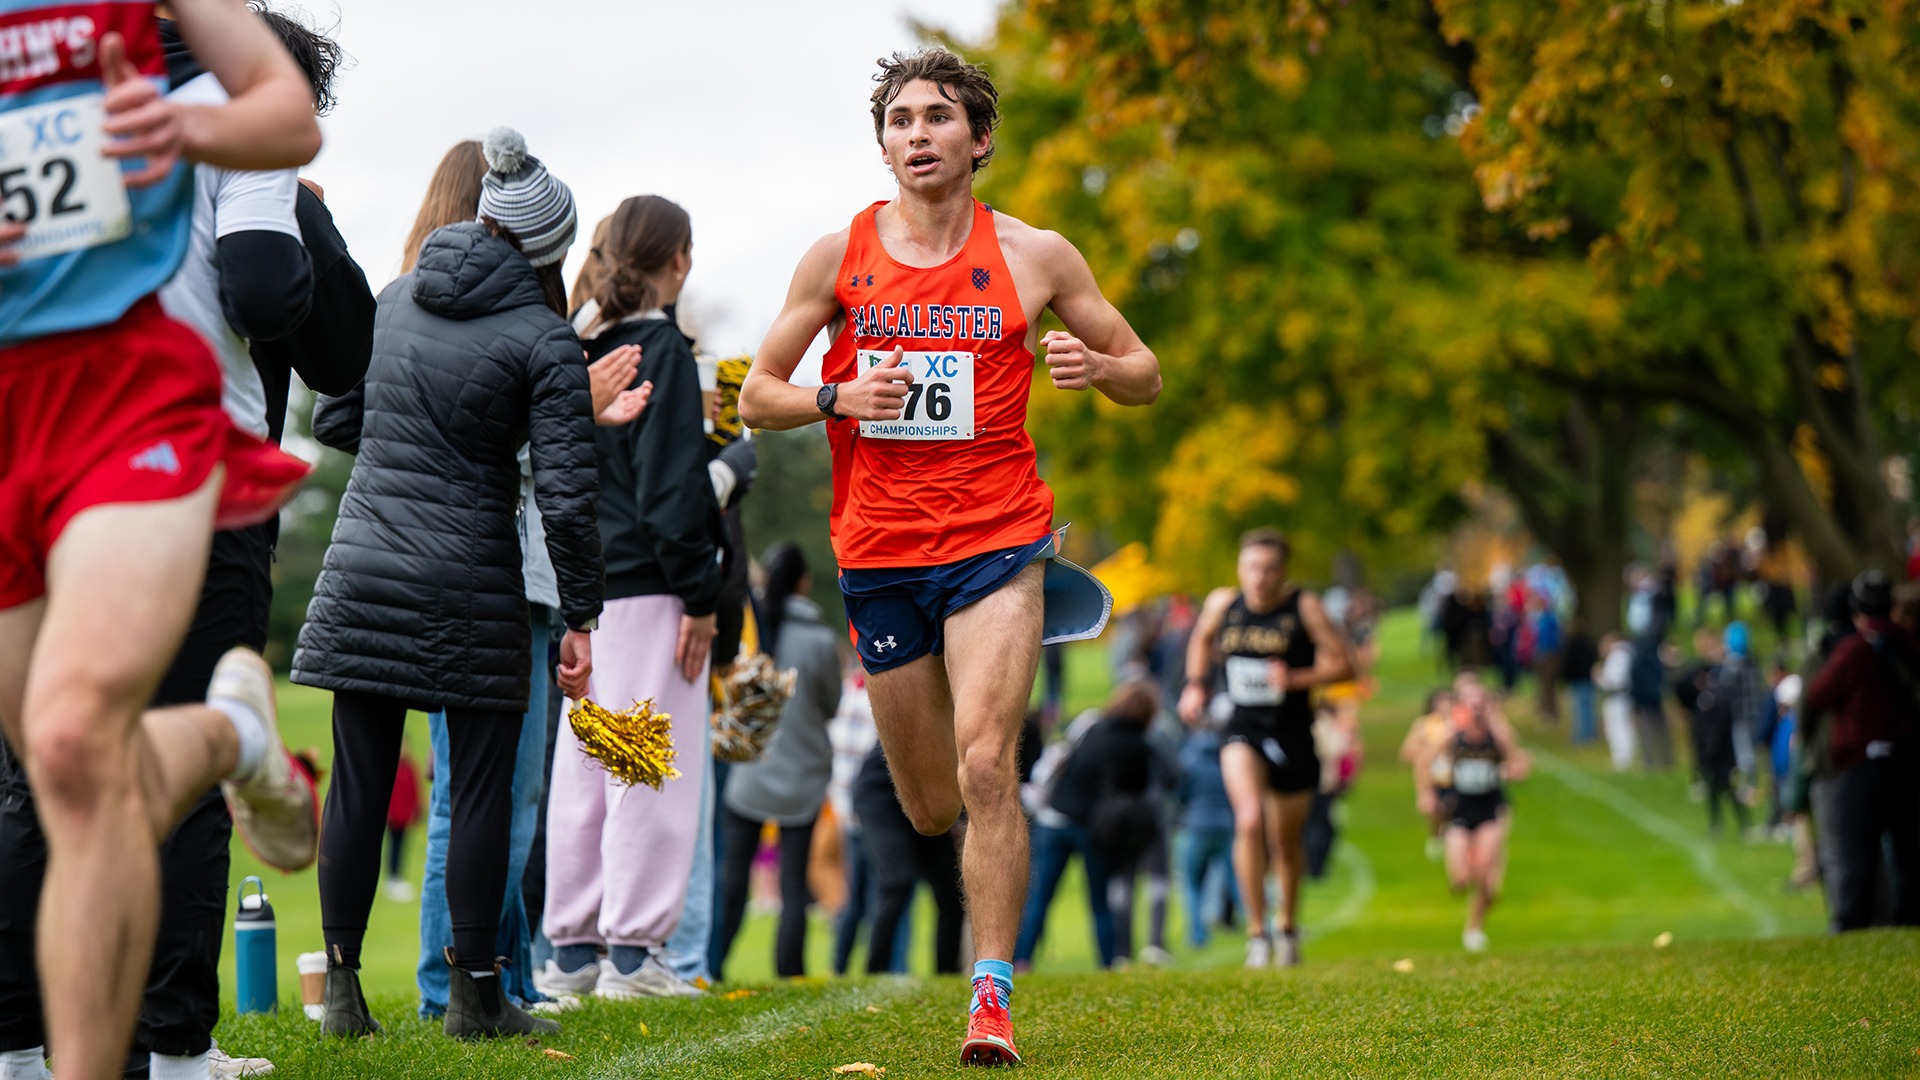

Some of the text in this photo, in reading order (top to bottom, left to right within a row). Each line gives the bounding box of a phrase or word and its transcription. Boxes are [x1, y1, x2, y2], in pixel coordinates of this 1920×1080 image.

[25, 109, 84, 152] XC
[850, 303, 1003, 341] MACALESTER
[925, 355, 958, 378] XC
[904, 382, 952, 421] 76
[870, 424, 958, 436] CHAMPIONSHIPS
